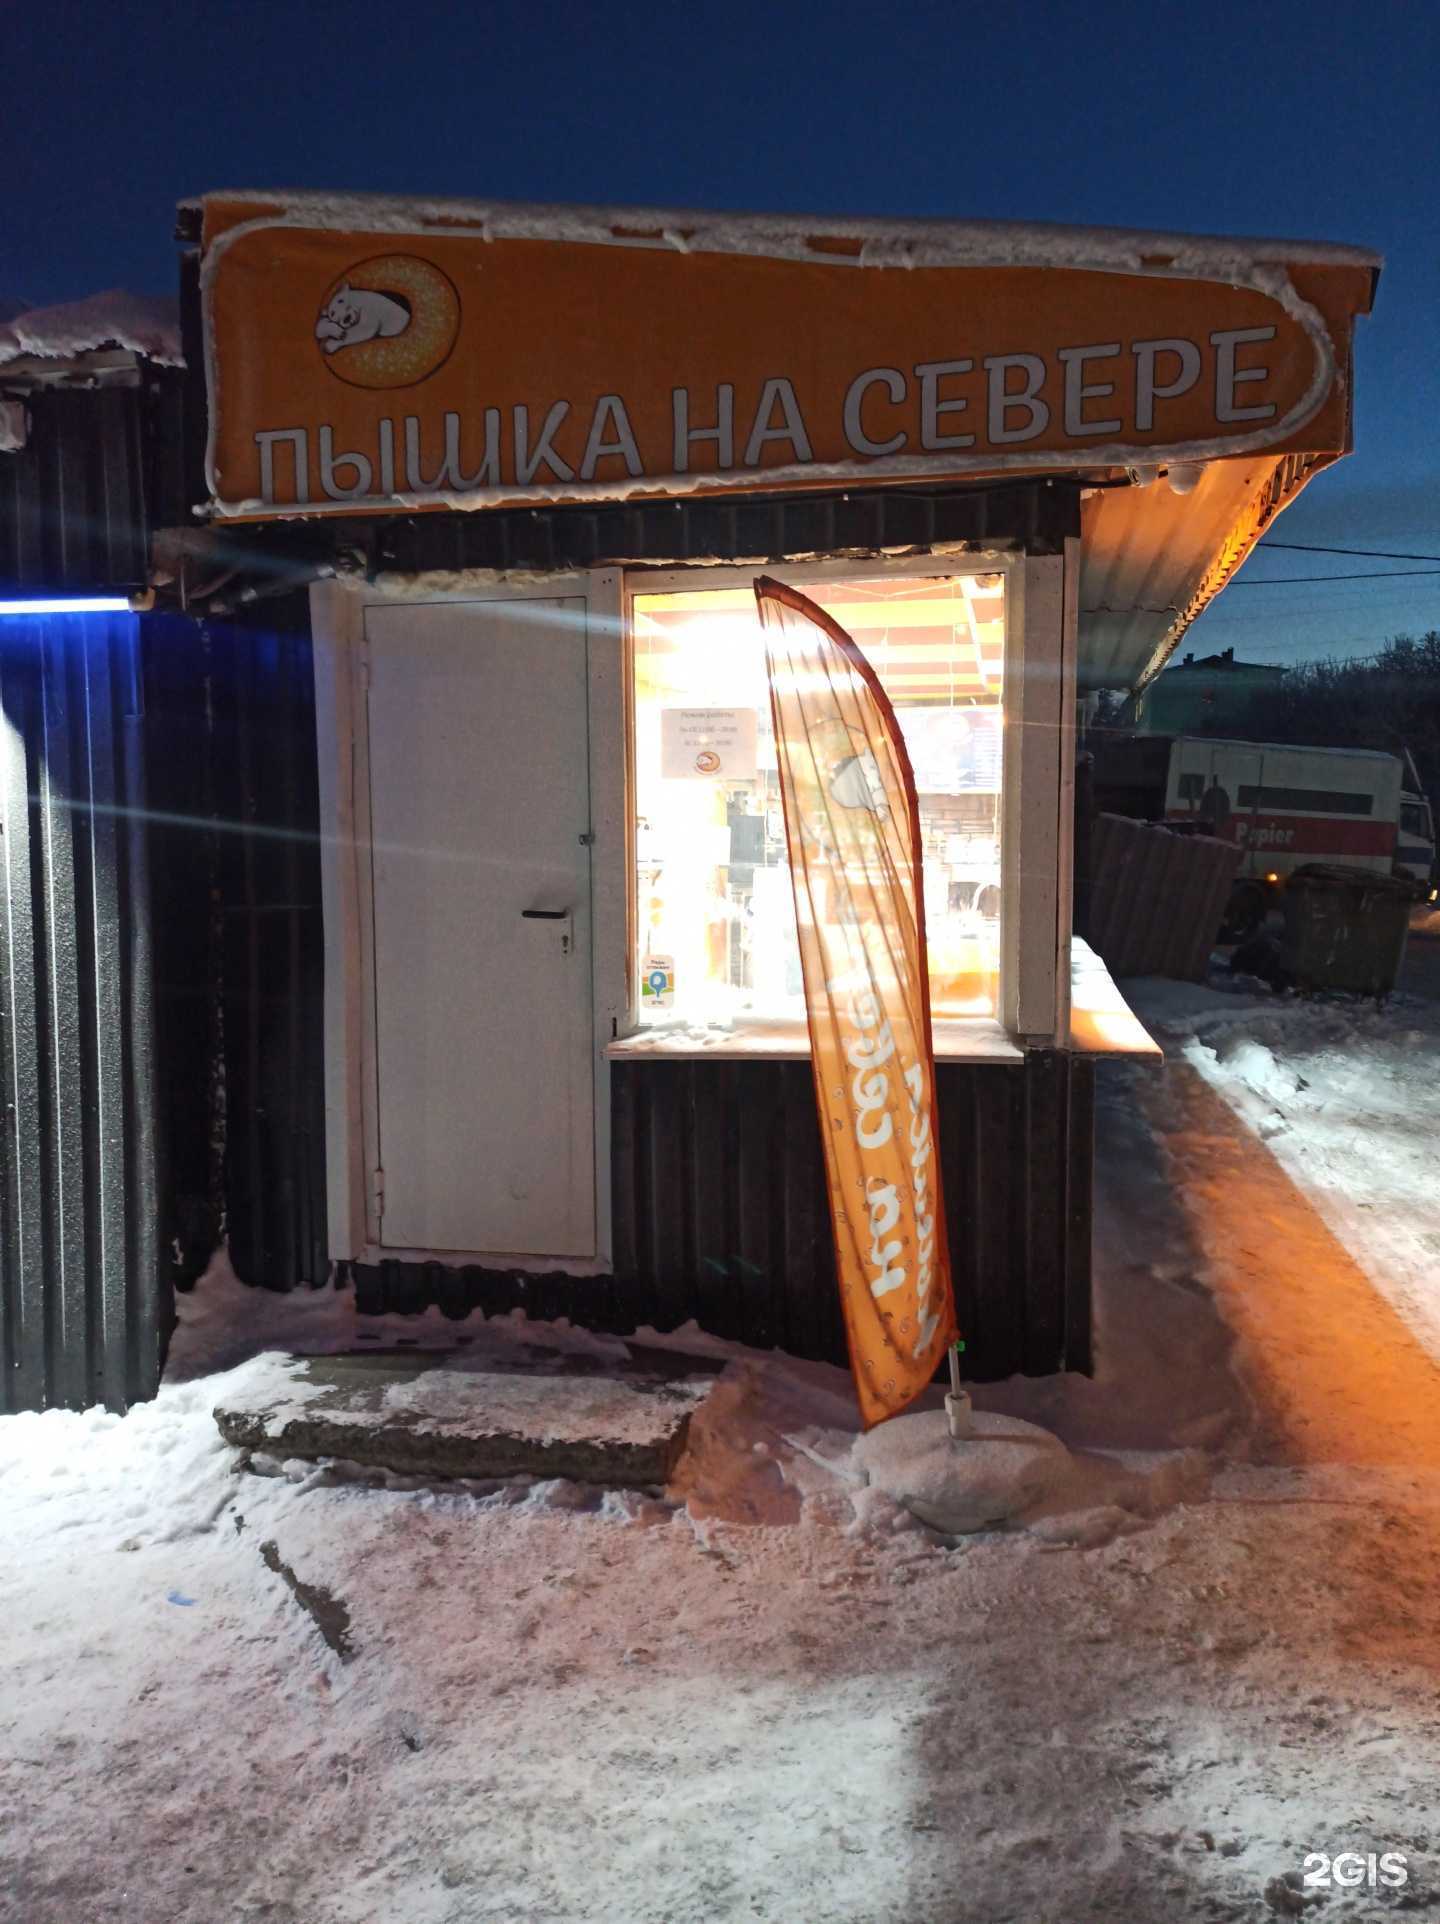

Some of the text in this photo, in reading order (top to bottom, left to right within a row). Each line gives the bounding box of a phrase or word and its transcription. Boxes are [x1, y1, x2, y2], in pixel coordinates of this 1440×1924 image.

[254, 325, 1278, 504] ПЫШКА НА СЕВЕРЕ
